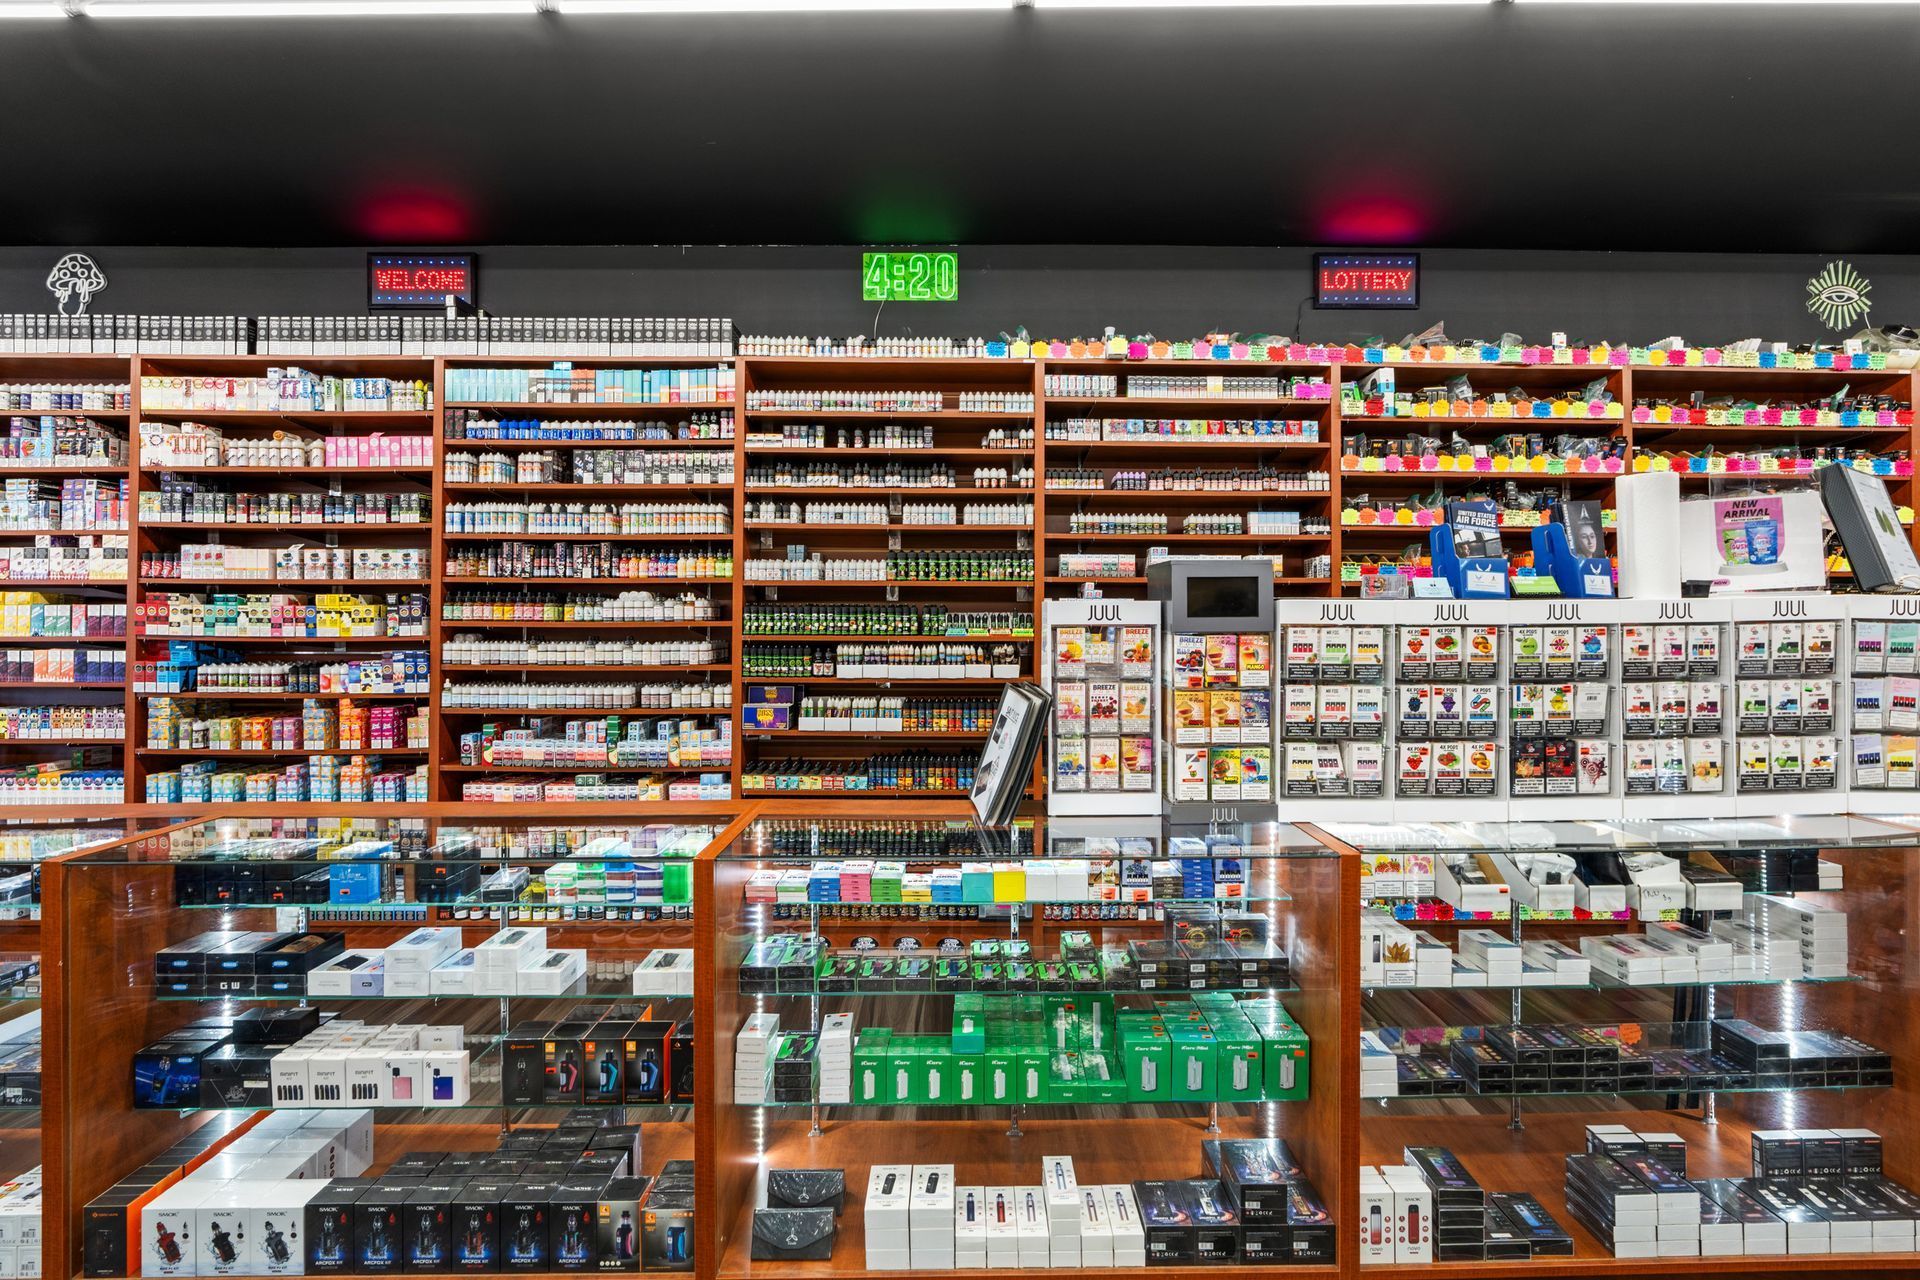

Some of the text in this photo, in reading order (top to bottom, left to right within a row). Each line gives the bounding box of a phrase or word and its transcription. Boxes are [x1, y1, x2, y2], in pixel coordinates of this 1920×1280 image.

[376, 270, 465, 289] WELCOME
[865, 254, 956, 299] 4:20
[1323, 271, 1412, 290] LOTTERY
[1732, 500, 1758, 509] NEW
[1456, 515, 1496, 528] AIR FORCE
[1477, 512, 1496, 520] STATES
[1724, 508, 1770, 519] ARRIVAL
[1088, 604, 1122, 620] JUUL
[1320, 604, 1355, 620] JUUL
[1434, 604, 1469, 620] JUUL
[1547, 604, 1582, 620] JUUL
[1659, 603, 1693, 619] JUUL
[1773, 600, 1807, 617] JUUL
[1179, 636, 1204, 644] BREEZE
[1211, 807, 1239, 821] JUUL
